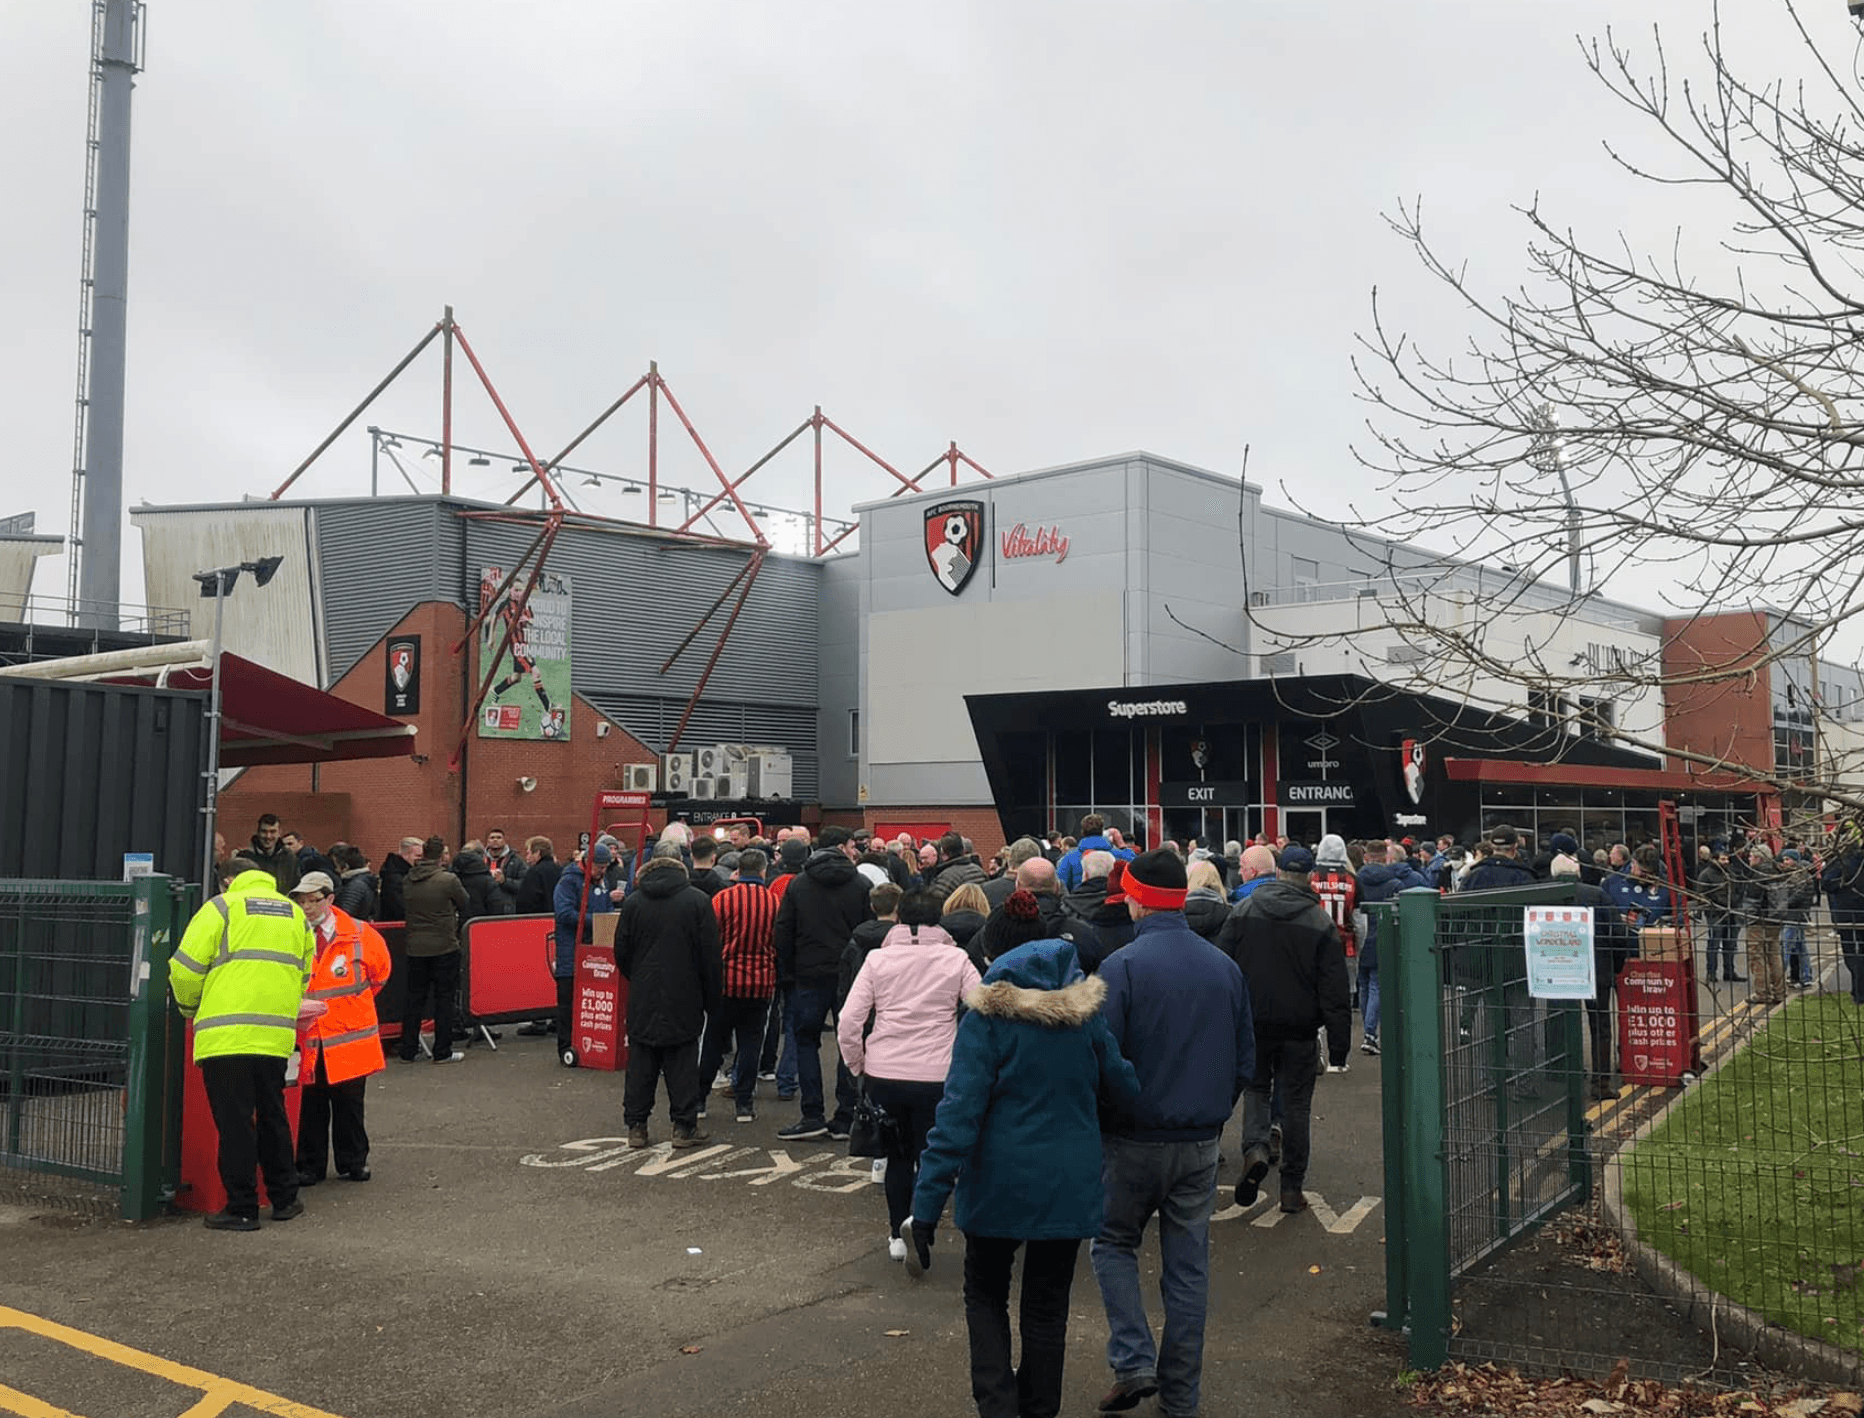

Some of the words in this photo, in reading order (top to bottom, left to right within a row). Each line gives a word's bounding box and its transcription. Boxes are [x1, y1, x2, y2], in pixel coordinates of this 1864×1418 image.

[1001, 522, 1070, 565] Vitality
[514, 642, 568, 661] COMMUNITY
[1108, 701, 1188, 719] Superstore
[1188, 787, 1215, 801] EXIT
[1289, 786, 1354, 800] ENTRANC
[582, 960, 616, 973] Community
[1624, 977, 1674, 988] Community
[582, 987, 595, 998] Win
[596, 990, 605, 1000] up
[1627, 1004, 1646, 1014] Win
[1648, 1006, 1662, 1016] up
[1664, 1005, 1675, 1014] to
[1628, 1028, 1648, 1038] plus
[1650, 1028, 1676, 1037] other
